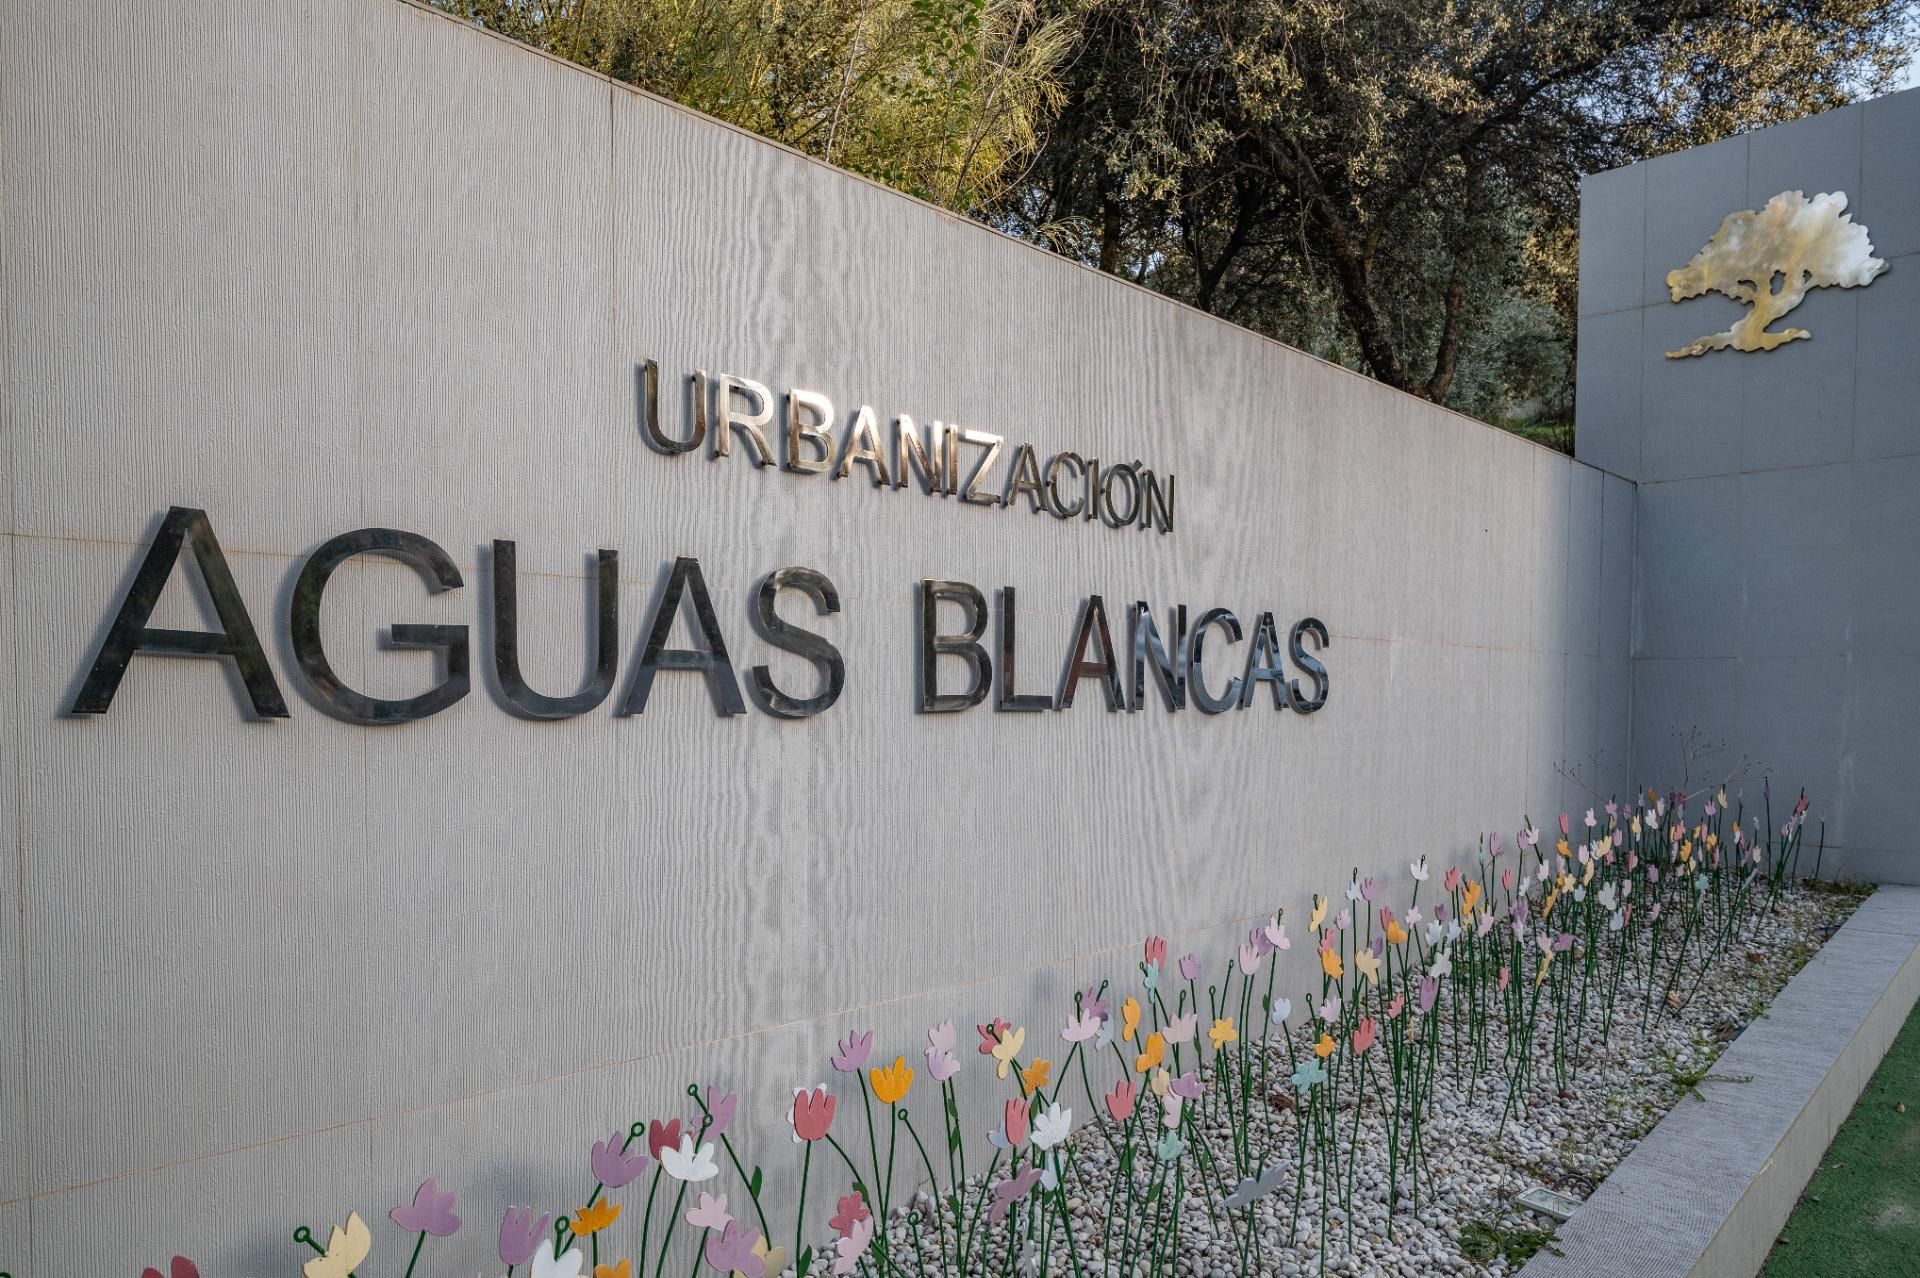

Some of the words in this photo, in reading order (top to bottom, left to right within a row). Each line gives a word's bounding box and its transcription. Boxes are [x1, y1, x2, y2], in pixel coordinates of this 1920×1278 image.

[643, 358, 1174, 533] URBANIZACIÓN
[70, 506, 846, 726] AGUAS
[919, 578, 1330, 715] BLANCAS
